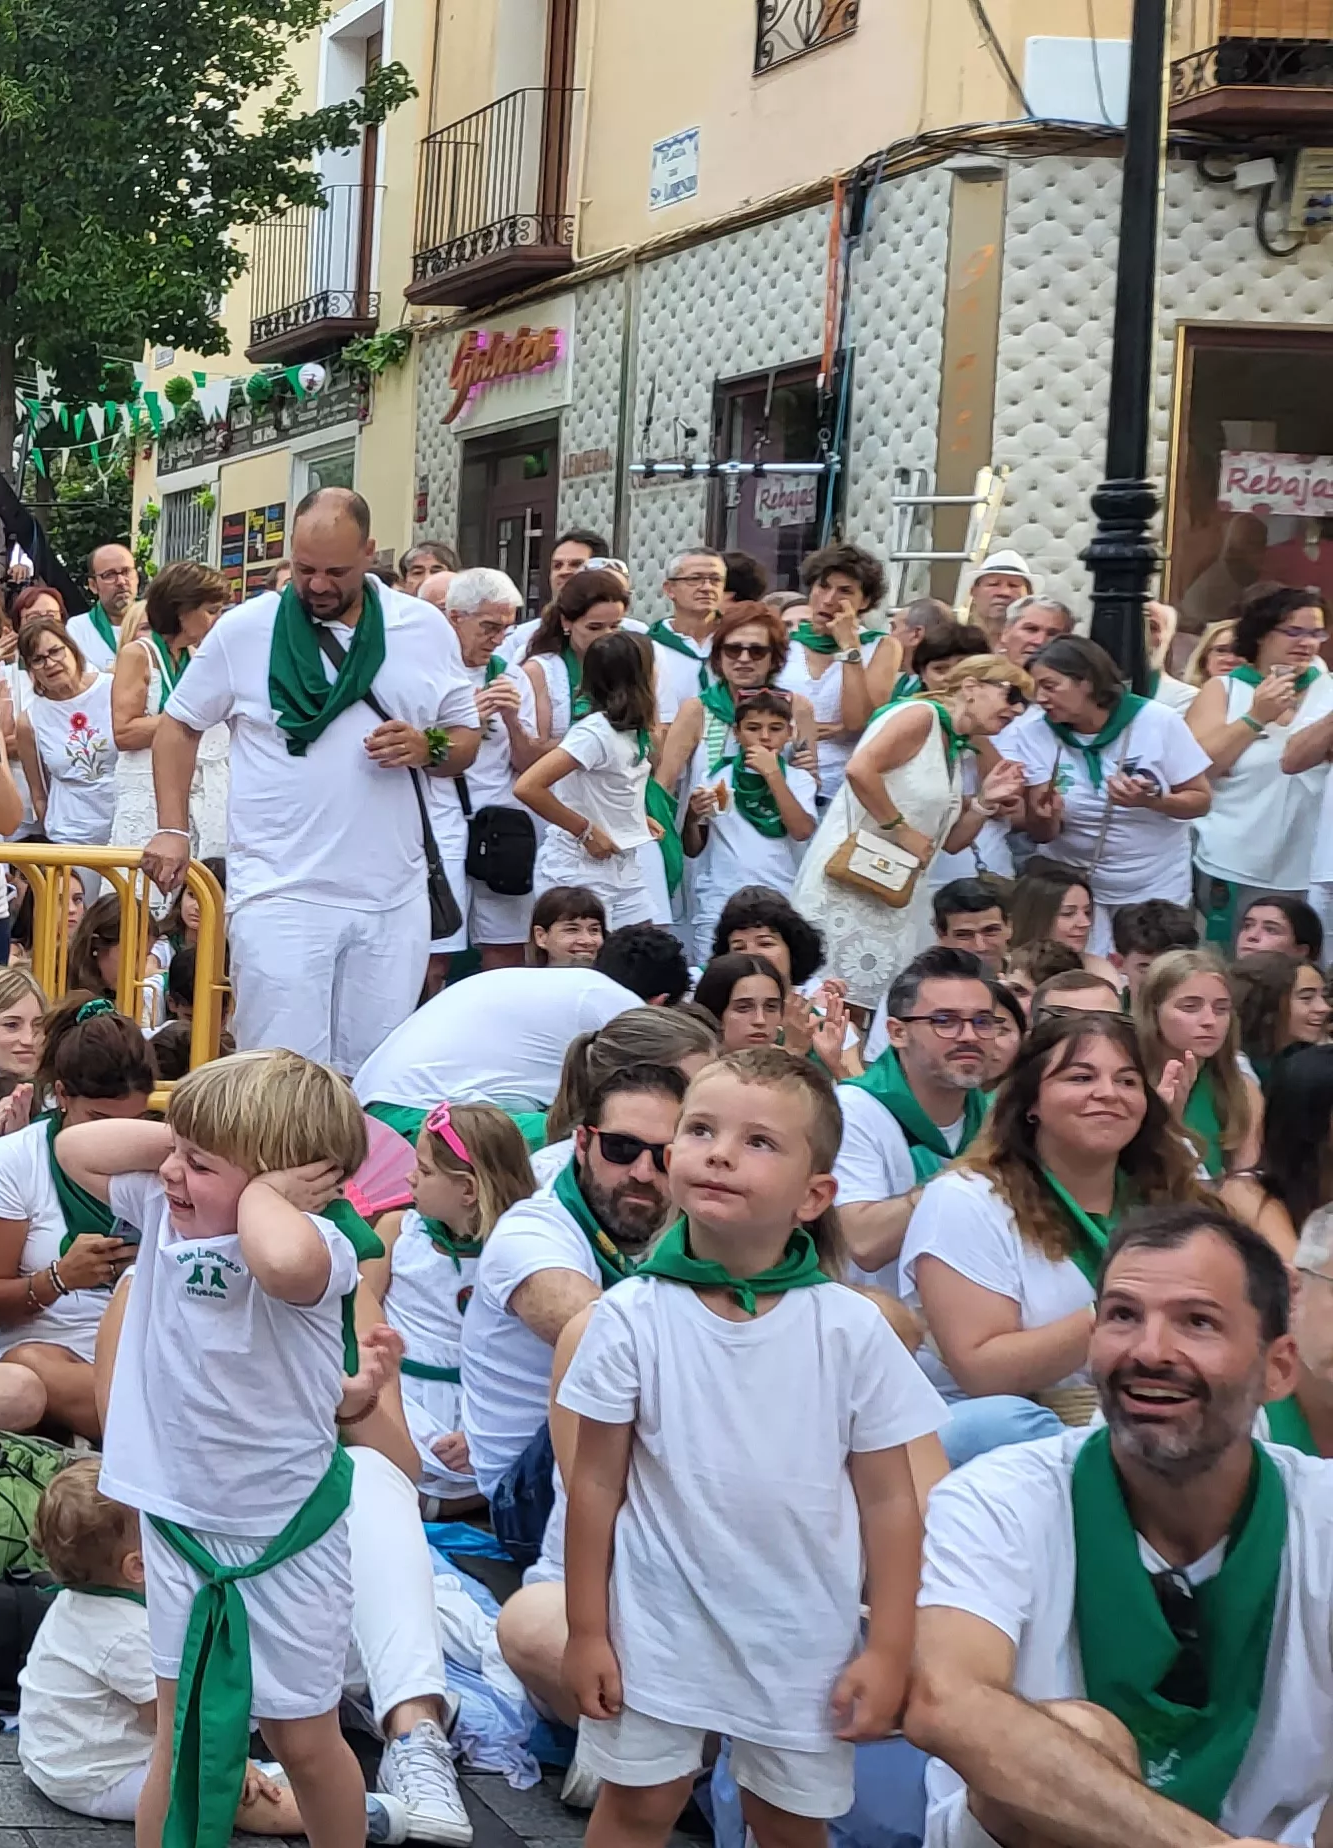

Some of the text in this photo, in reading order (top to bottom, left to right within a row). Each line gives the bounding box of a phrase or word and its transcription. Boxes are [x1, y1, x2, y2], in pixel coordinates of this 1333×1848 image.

[1227, 466, 1333, 507] Rebaja
[176, 1246, 242, 1274] San Lorenzo
